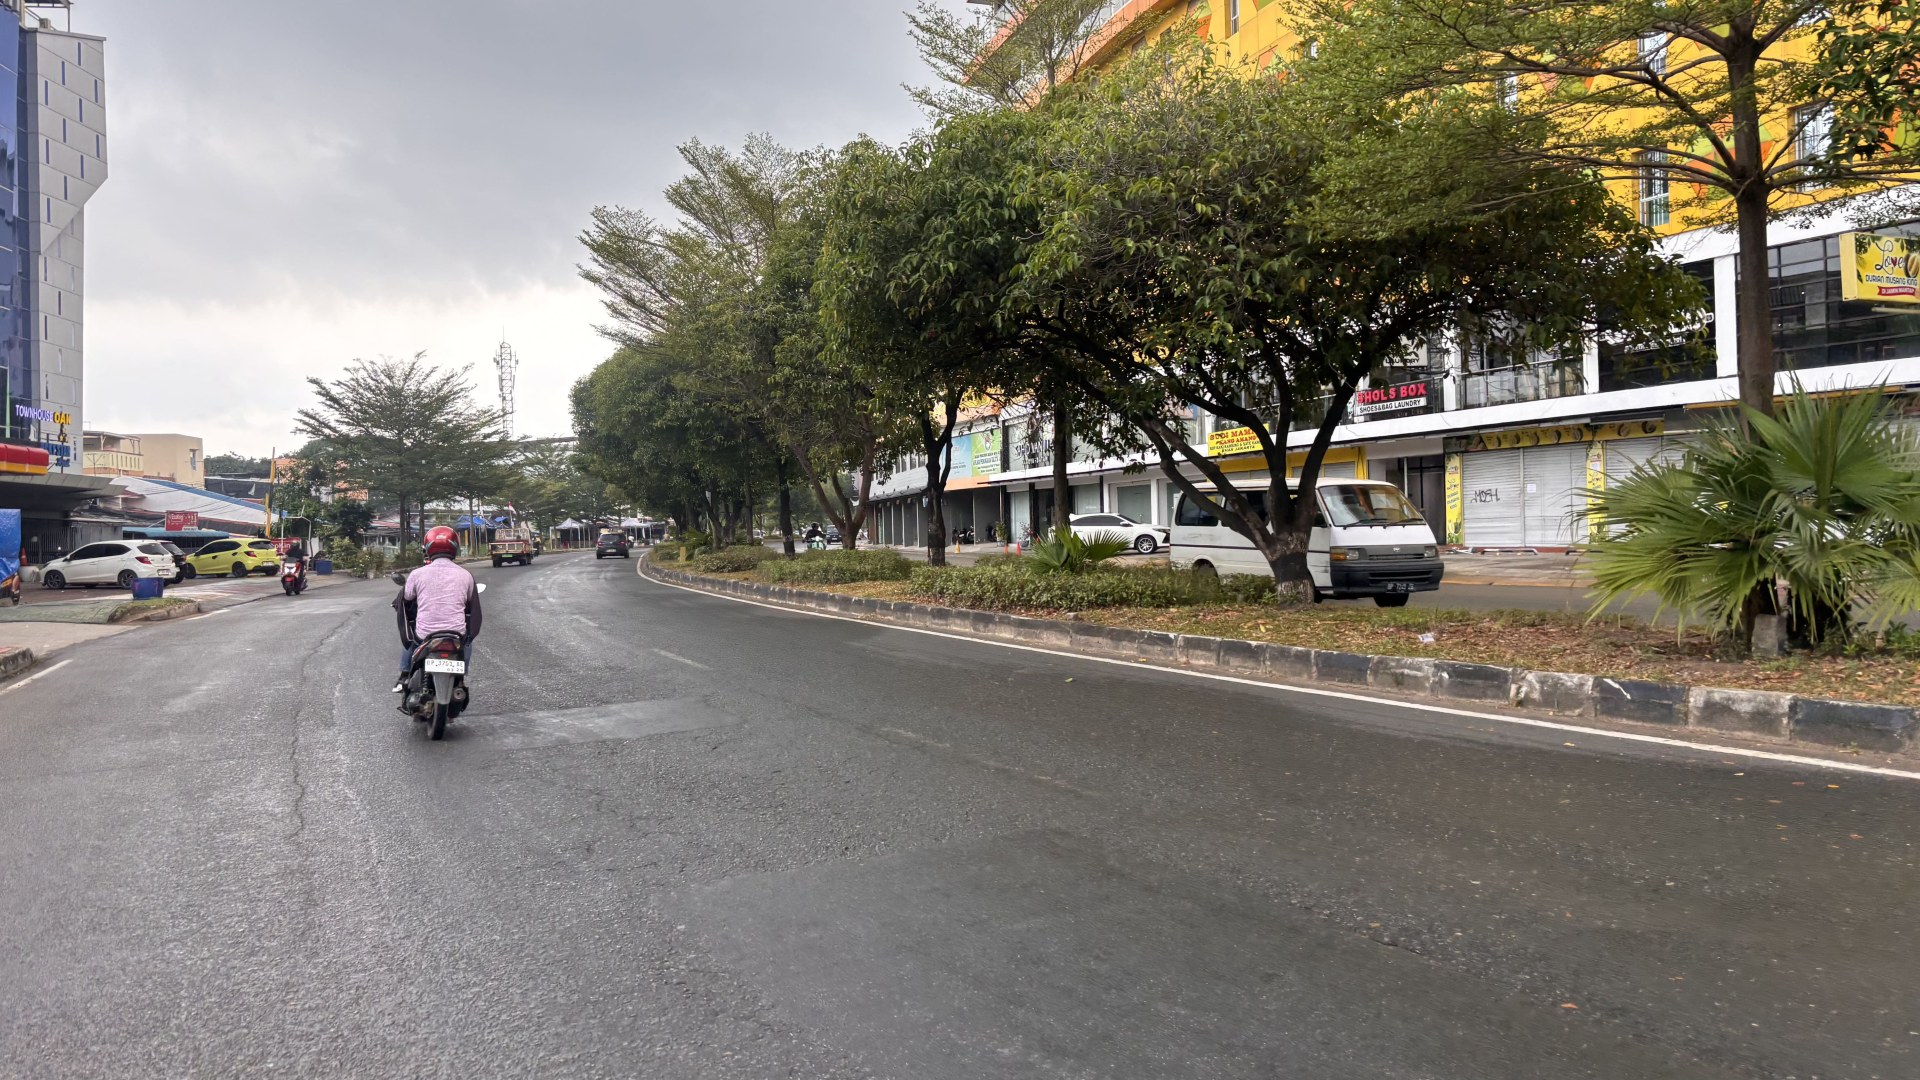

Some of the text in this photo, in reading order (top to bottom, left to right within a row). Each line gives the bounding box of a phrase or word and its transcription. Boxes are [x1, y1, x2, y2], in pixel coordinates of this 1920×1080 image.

[1874, 239, 1905, 276] Love
[1865, 274, 1918, 287] DURIAN MUSANG KING
[1400, 383, 1427, 398] BOX
[1394, 399, 1421, 409] LAUNDRY
[15, 404, 53, 422] TOWNHOUSE
